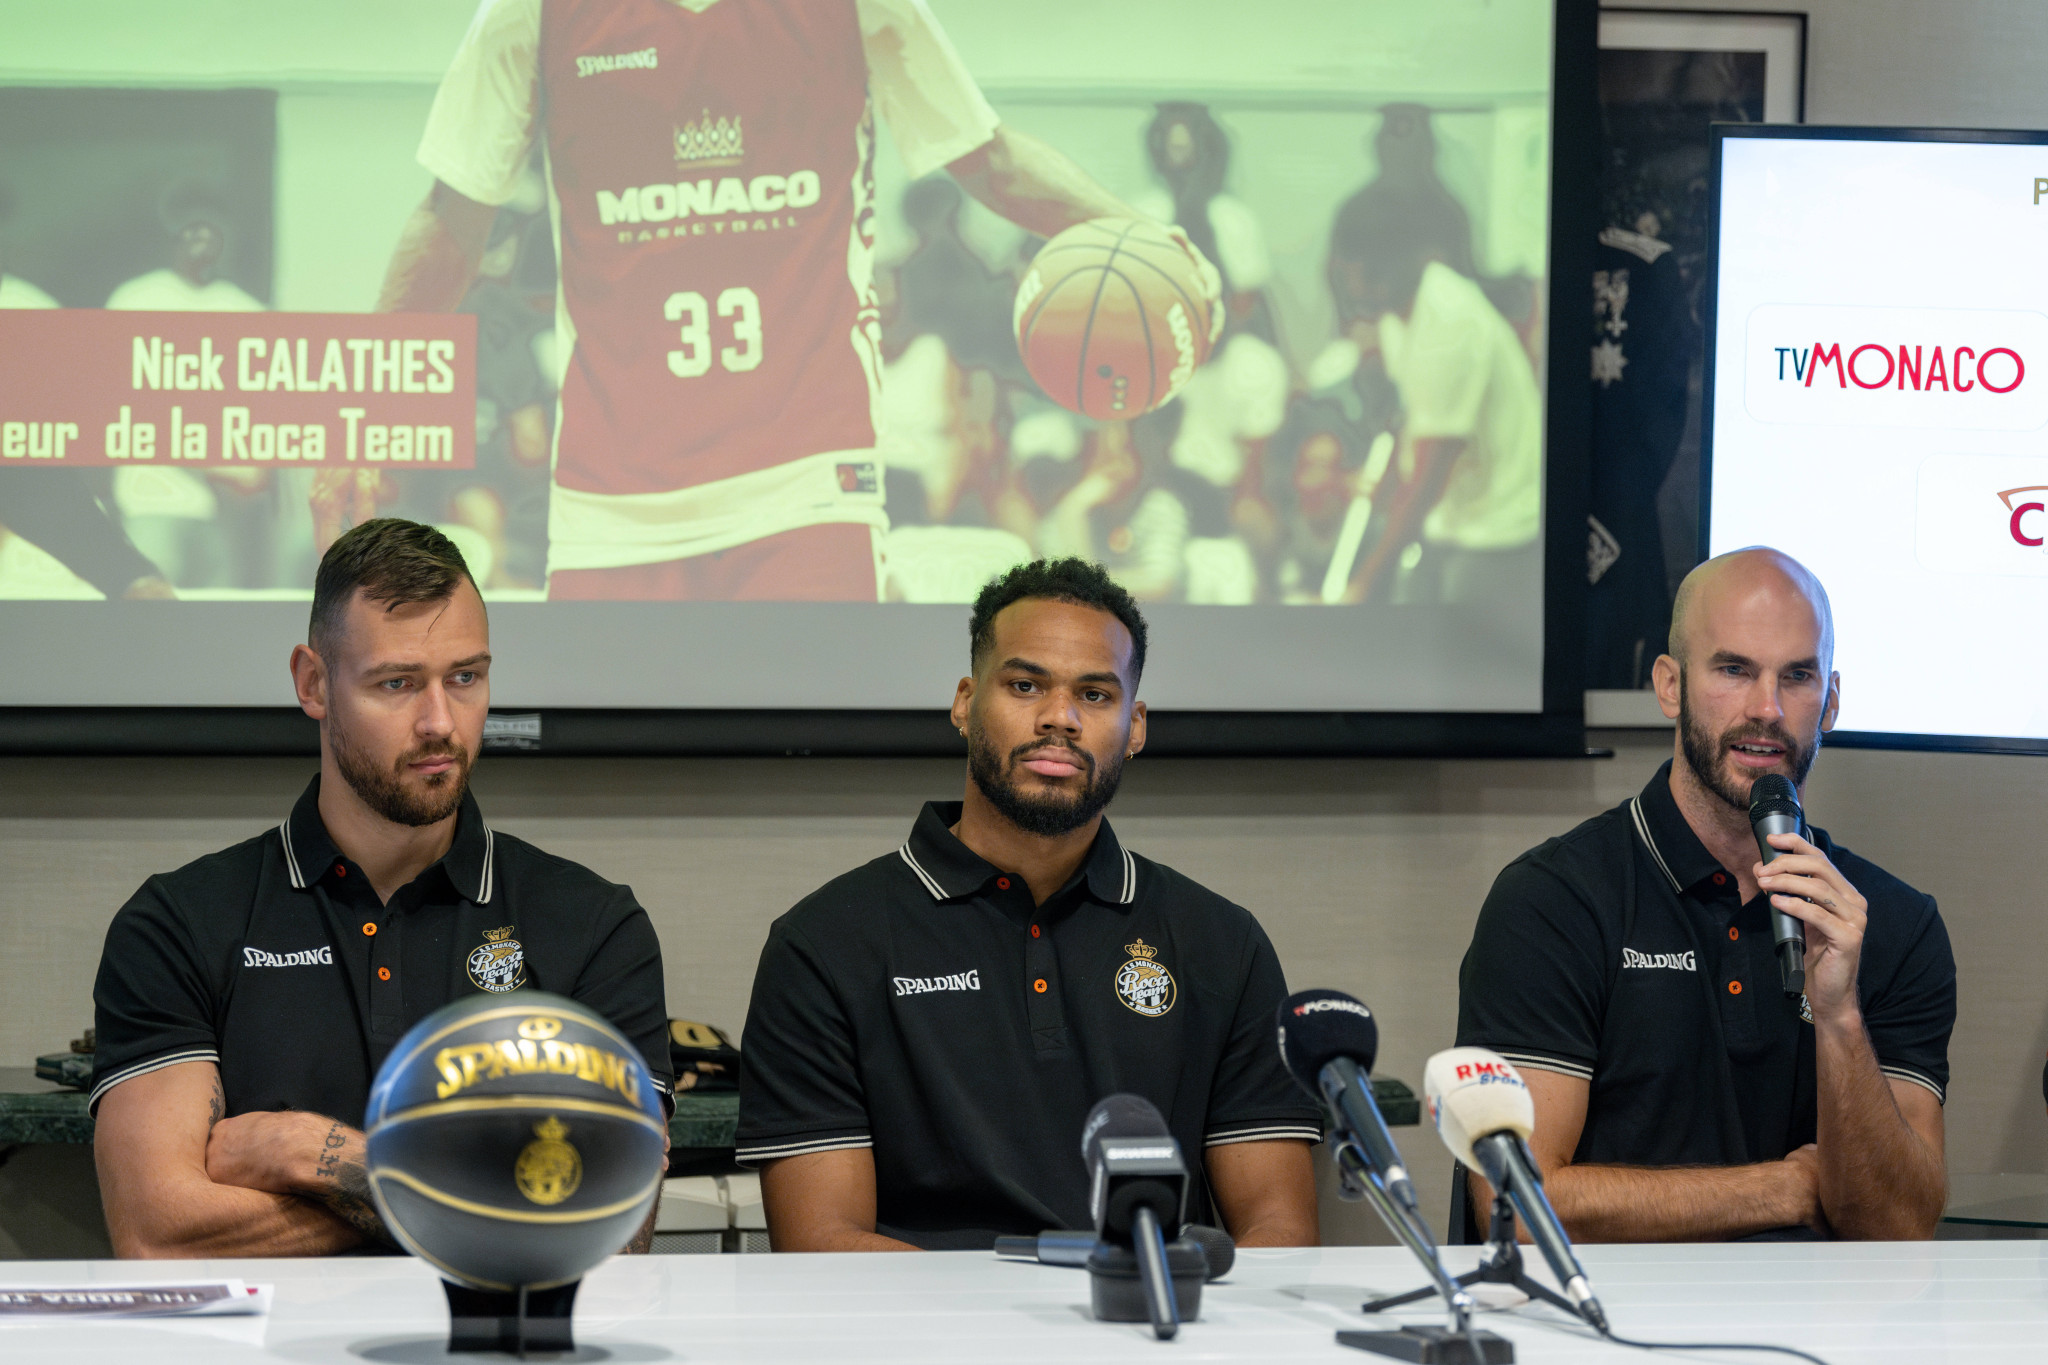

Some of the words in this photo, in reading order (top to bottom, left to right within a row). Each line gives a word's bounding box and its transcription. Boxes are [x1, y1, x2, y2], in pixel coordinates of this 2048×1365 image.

[596, 169, 821, 225] MONACO
[664, 287, 763, 378] 33
[132, 336, 225, 391] Nick
[237, 337, 455, 393] CALATHES
[2, 421, 79, 459] eur
[105, 405, 156, 460] de
[171, 406, 208, 460] la
[222, 406, 327, 461] Roca
[339, 407, 454, 462] Team
[243, 945, 333, 968] SPALDING
[1622, 947, 1697, 972] SPALDING
[484, 982, 514, 992] BASKET
[893, 969, 981, 997] SPALDING
[434, 1039, 642, 1108] SPALDING
[1456, 1062, 1511, 1081] RMC
